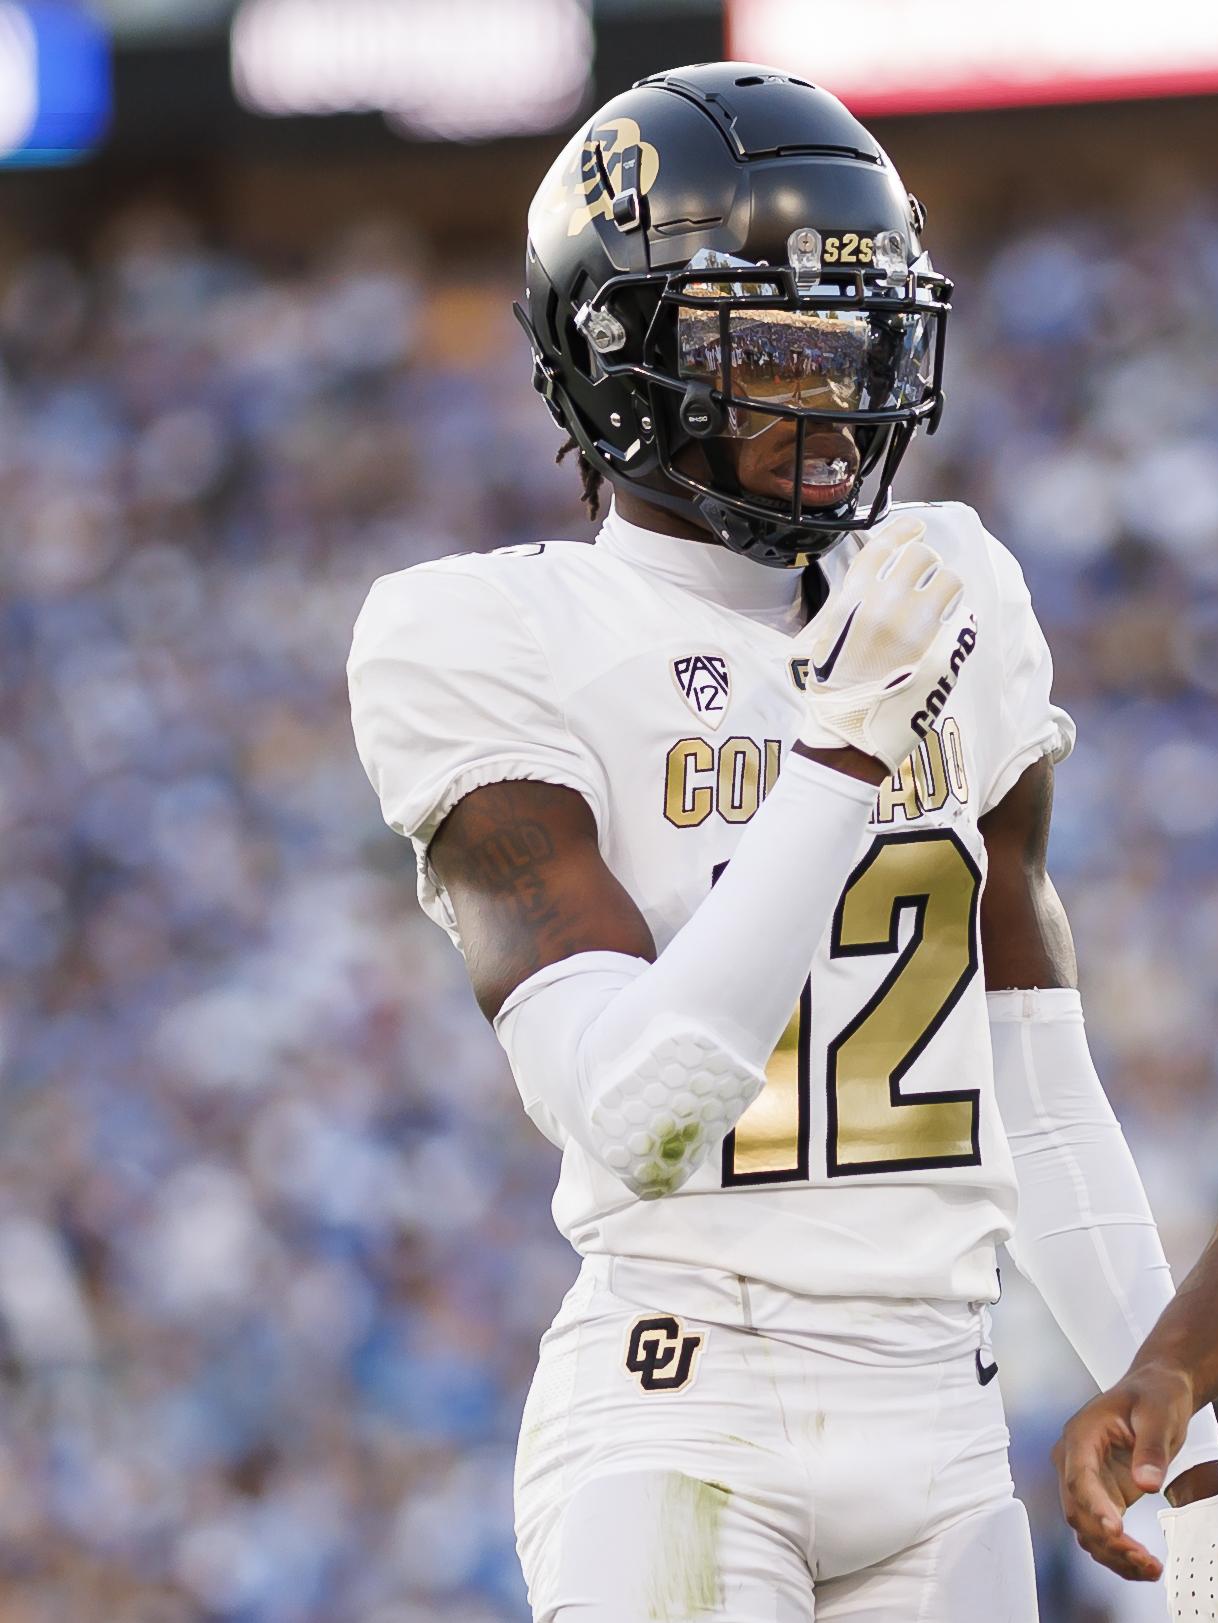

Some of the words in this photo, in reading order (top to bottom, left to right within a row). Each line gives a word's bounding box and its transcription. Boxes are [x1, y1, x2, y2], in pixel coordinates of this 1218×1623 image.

[673, 655, 729, 699] PAC
[693, 684, 723, 712] 12
[625, 1316, 702, 1391] CU
